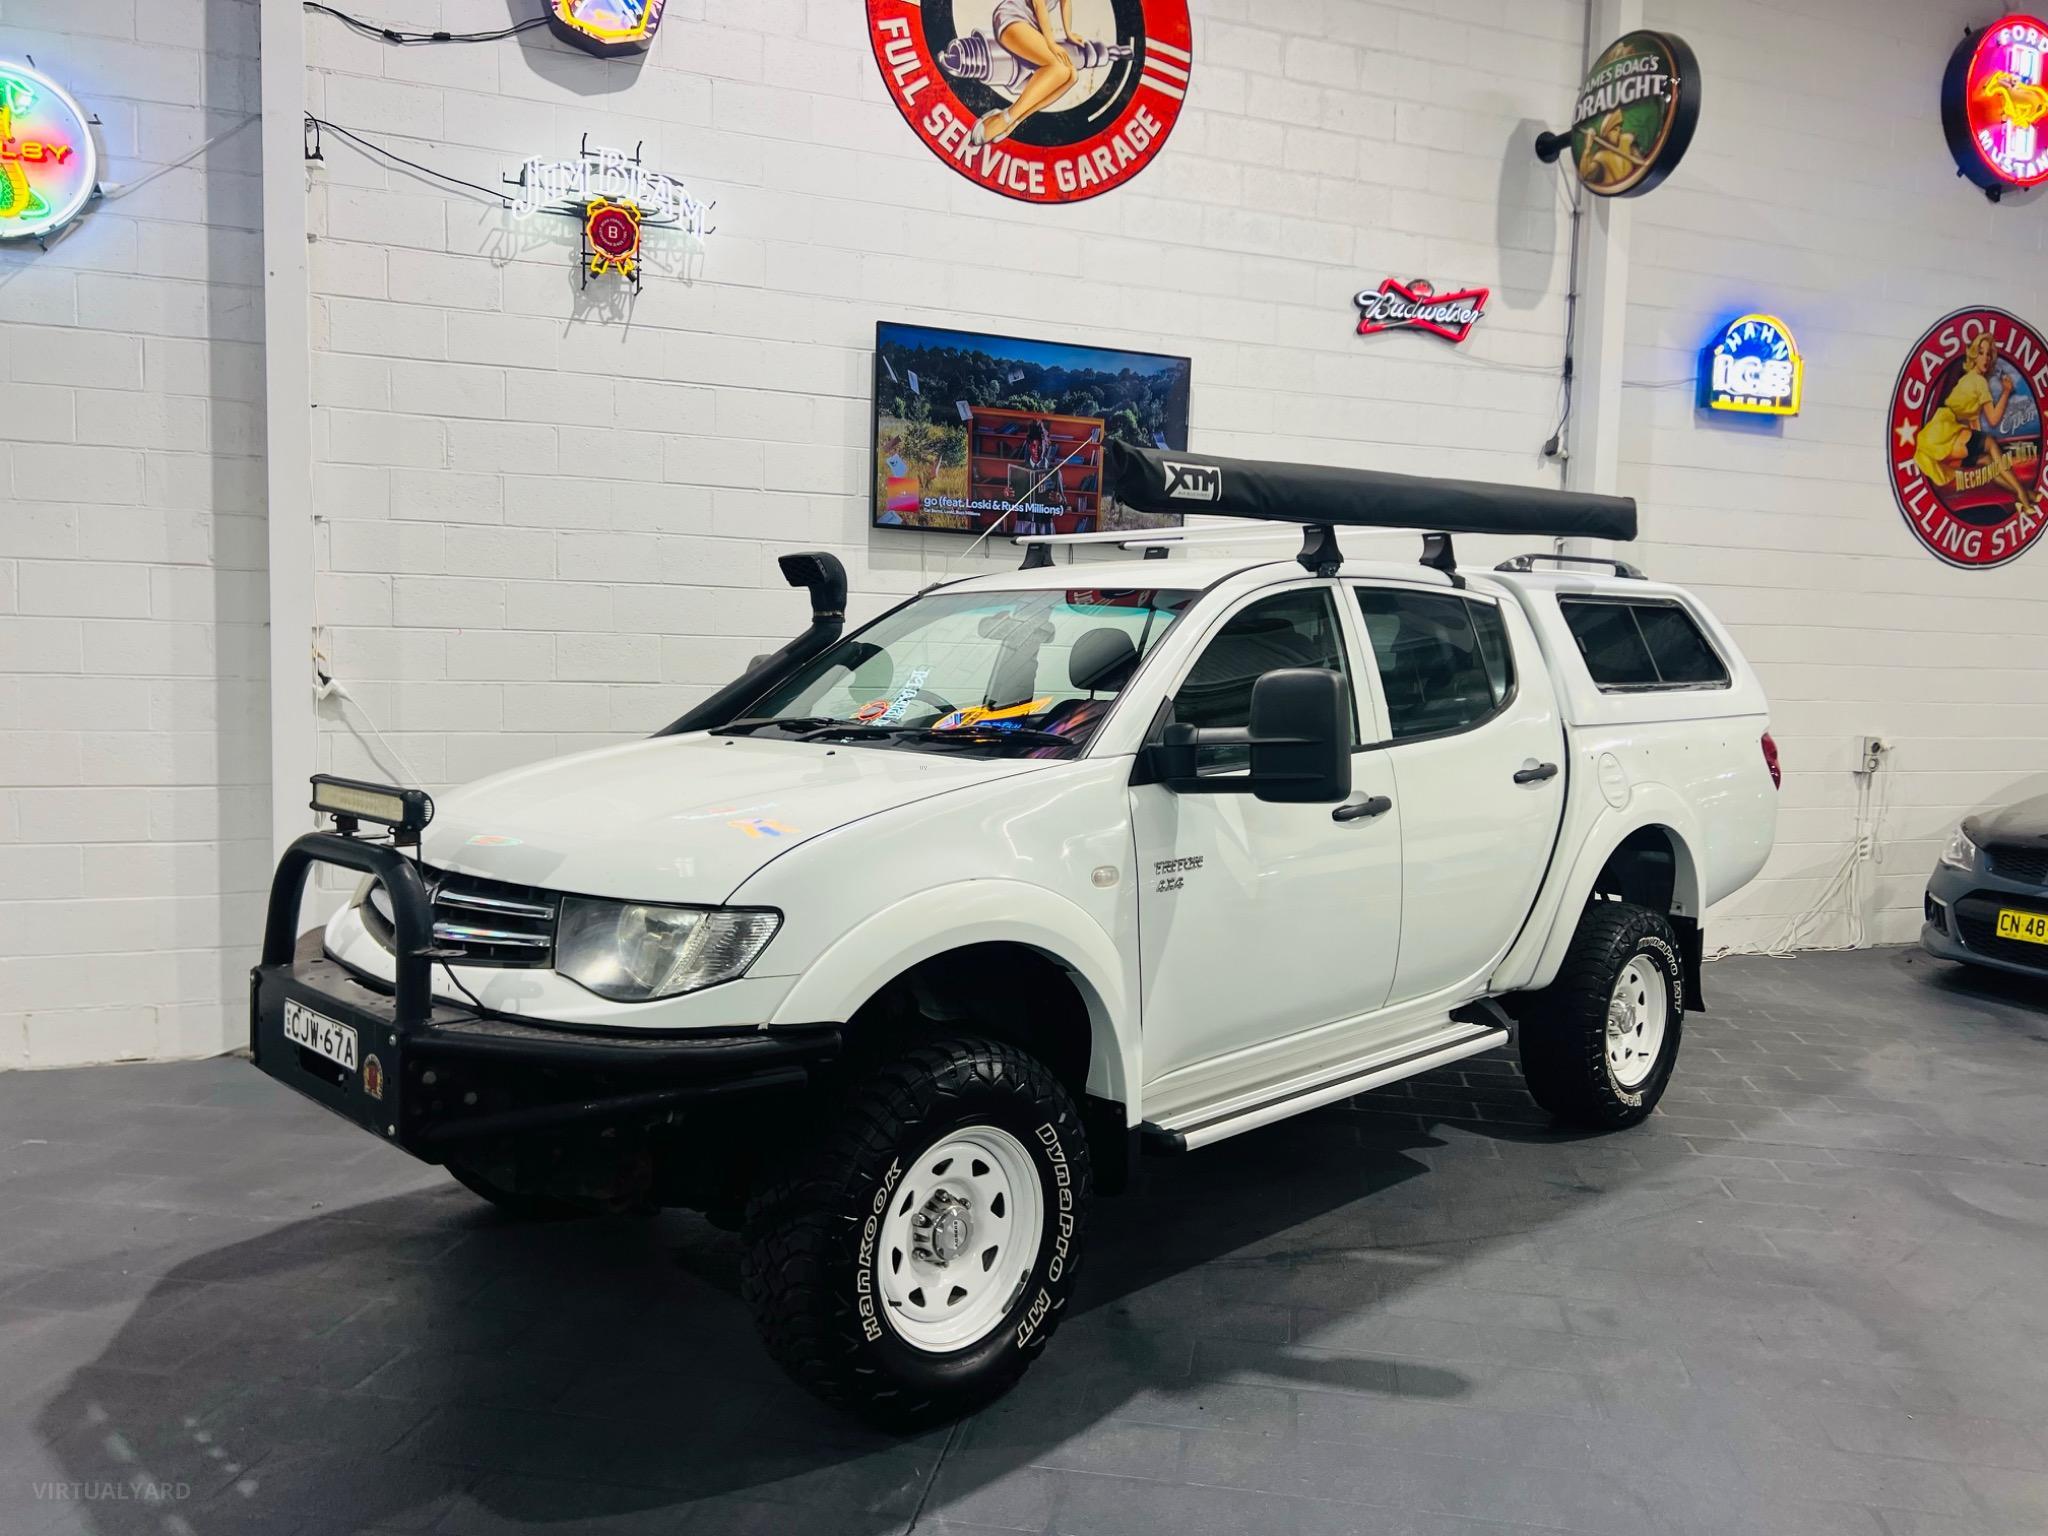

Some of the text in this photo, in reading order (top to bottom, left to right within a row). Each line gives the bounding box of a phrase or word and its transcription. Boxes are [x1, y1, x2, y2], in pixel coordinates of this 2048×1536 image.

[1615, 55, 1660, 78] BOAG'S
[879, 17, 1163, 194] FULL SERVICE GARAGE
[512, 147, 706, 244] JIM BEAM
[1355, 289, 1482, 324] Budweiser
[1726, 322, 1788, 360] HAHN
[1904, 319, 2048, 410] GASOLINE
[1165, 465, 1218, 501] XTM
[924, 498, 938, 507] go
[966, 498, 991, 510] Loski
[992, 501, 1001, 510] &
[1025, 502, 1065, 516] Millions)
[1898, 458, 1982, 557] FILLING
[2000, 914, 2021, 933] CN
[1017, 1288, 1051, 1348] MT
